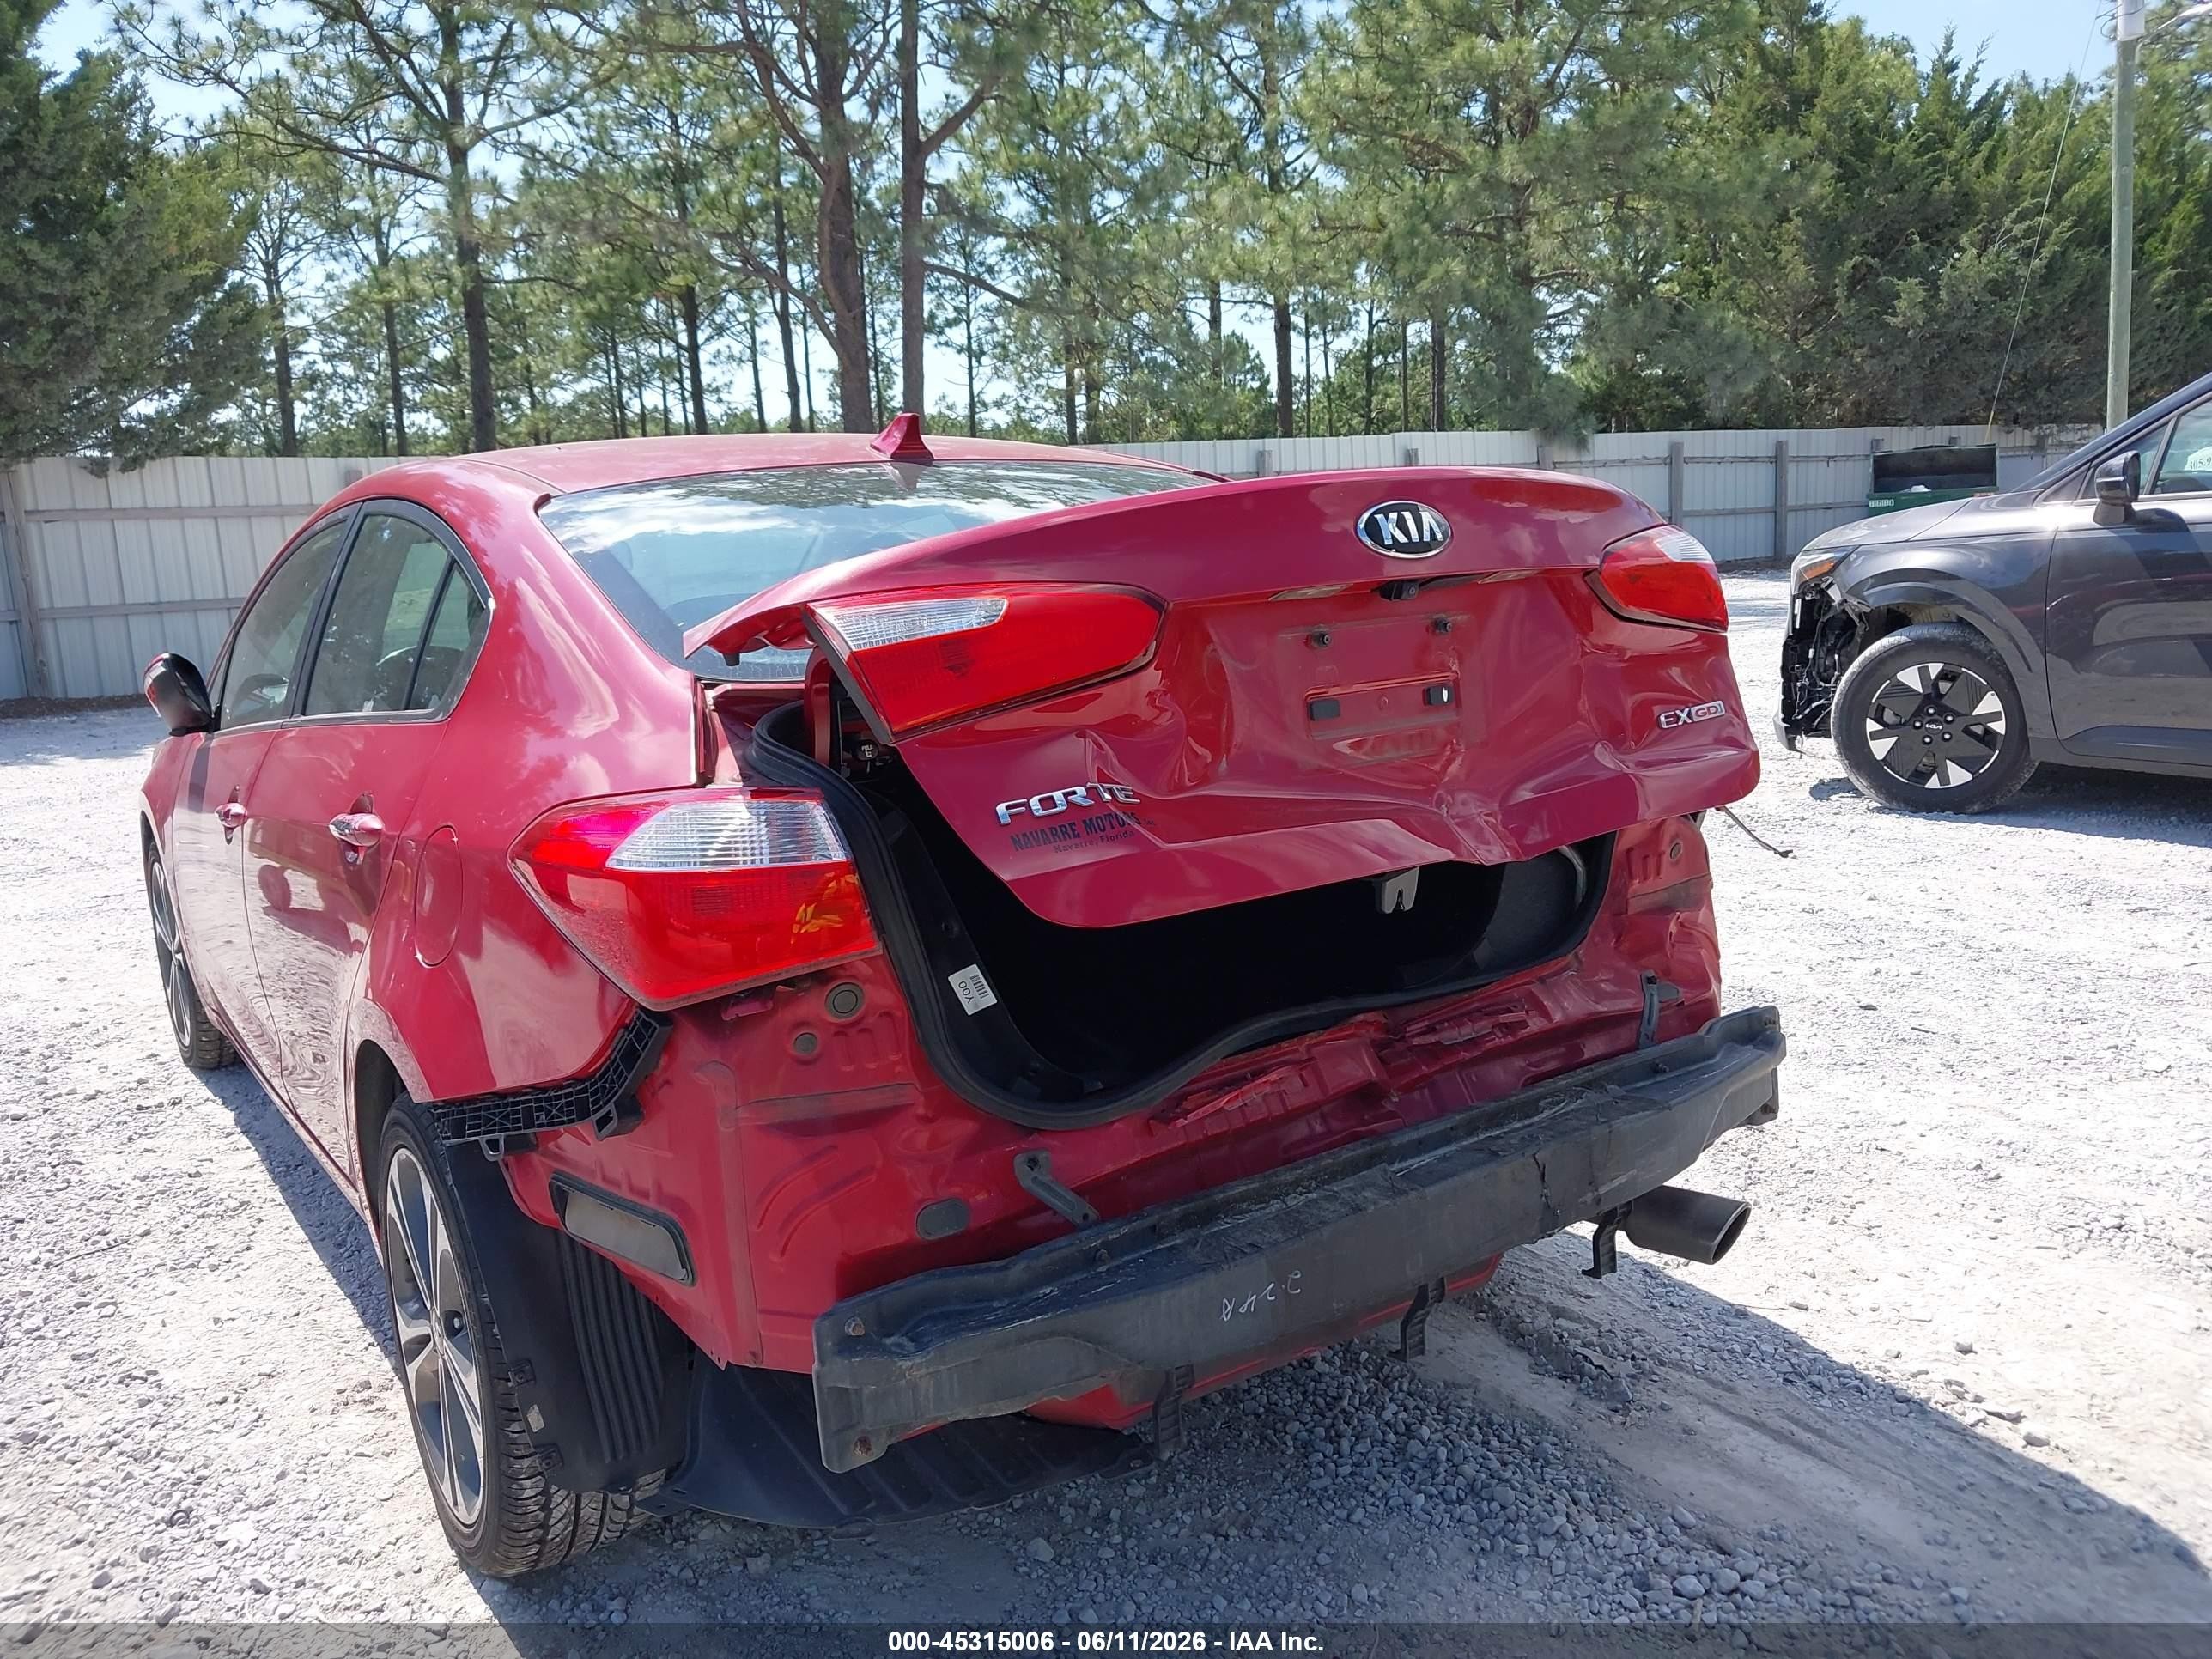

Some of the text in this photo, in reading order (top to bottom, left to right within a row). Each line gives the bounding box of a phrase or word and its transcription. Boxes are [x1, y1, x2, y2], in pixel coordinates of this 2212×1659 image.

[1374, 510, 1444, 545] KIA
[1659, 708, 1692, 729] EX
[995, 781, 1141, 825] FORTE
[1010, 821, 1081, 852] NAVARRE
